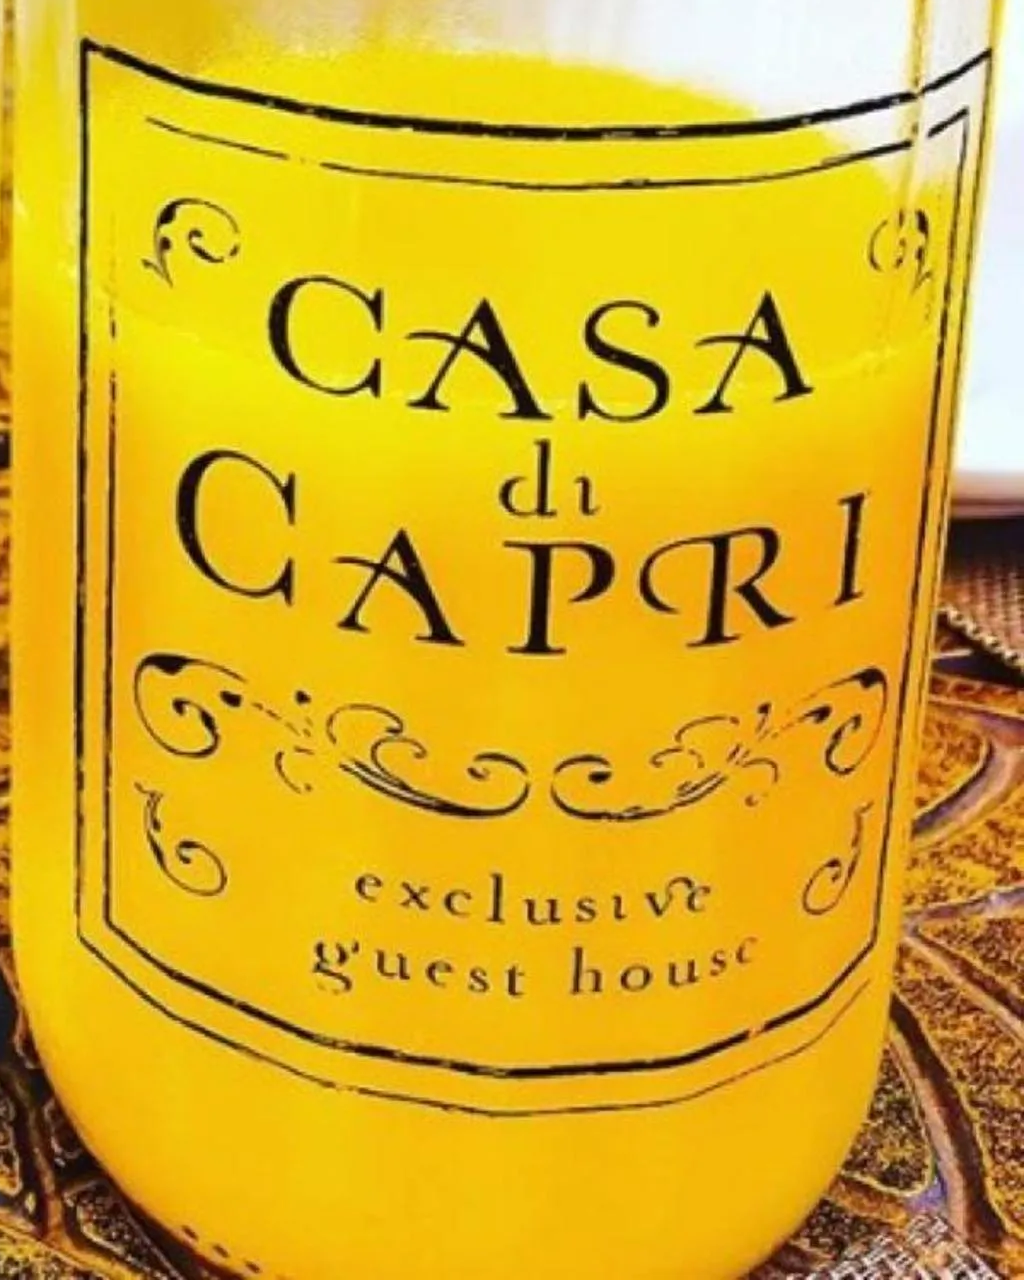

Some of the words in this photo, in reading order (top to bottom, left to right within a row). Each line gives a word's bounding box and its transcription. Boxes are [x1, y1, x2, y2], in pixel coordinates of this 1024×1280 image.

[266, 274, 814, 422] CASA
[498, 438, 602, 517] di
[176, 449, 872, 656] CAPRI
[354, 873, 712, 925] exclusive
[312, 938, 526, 995] guest
[569, 935, 758, 997] house
